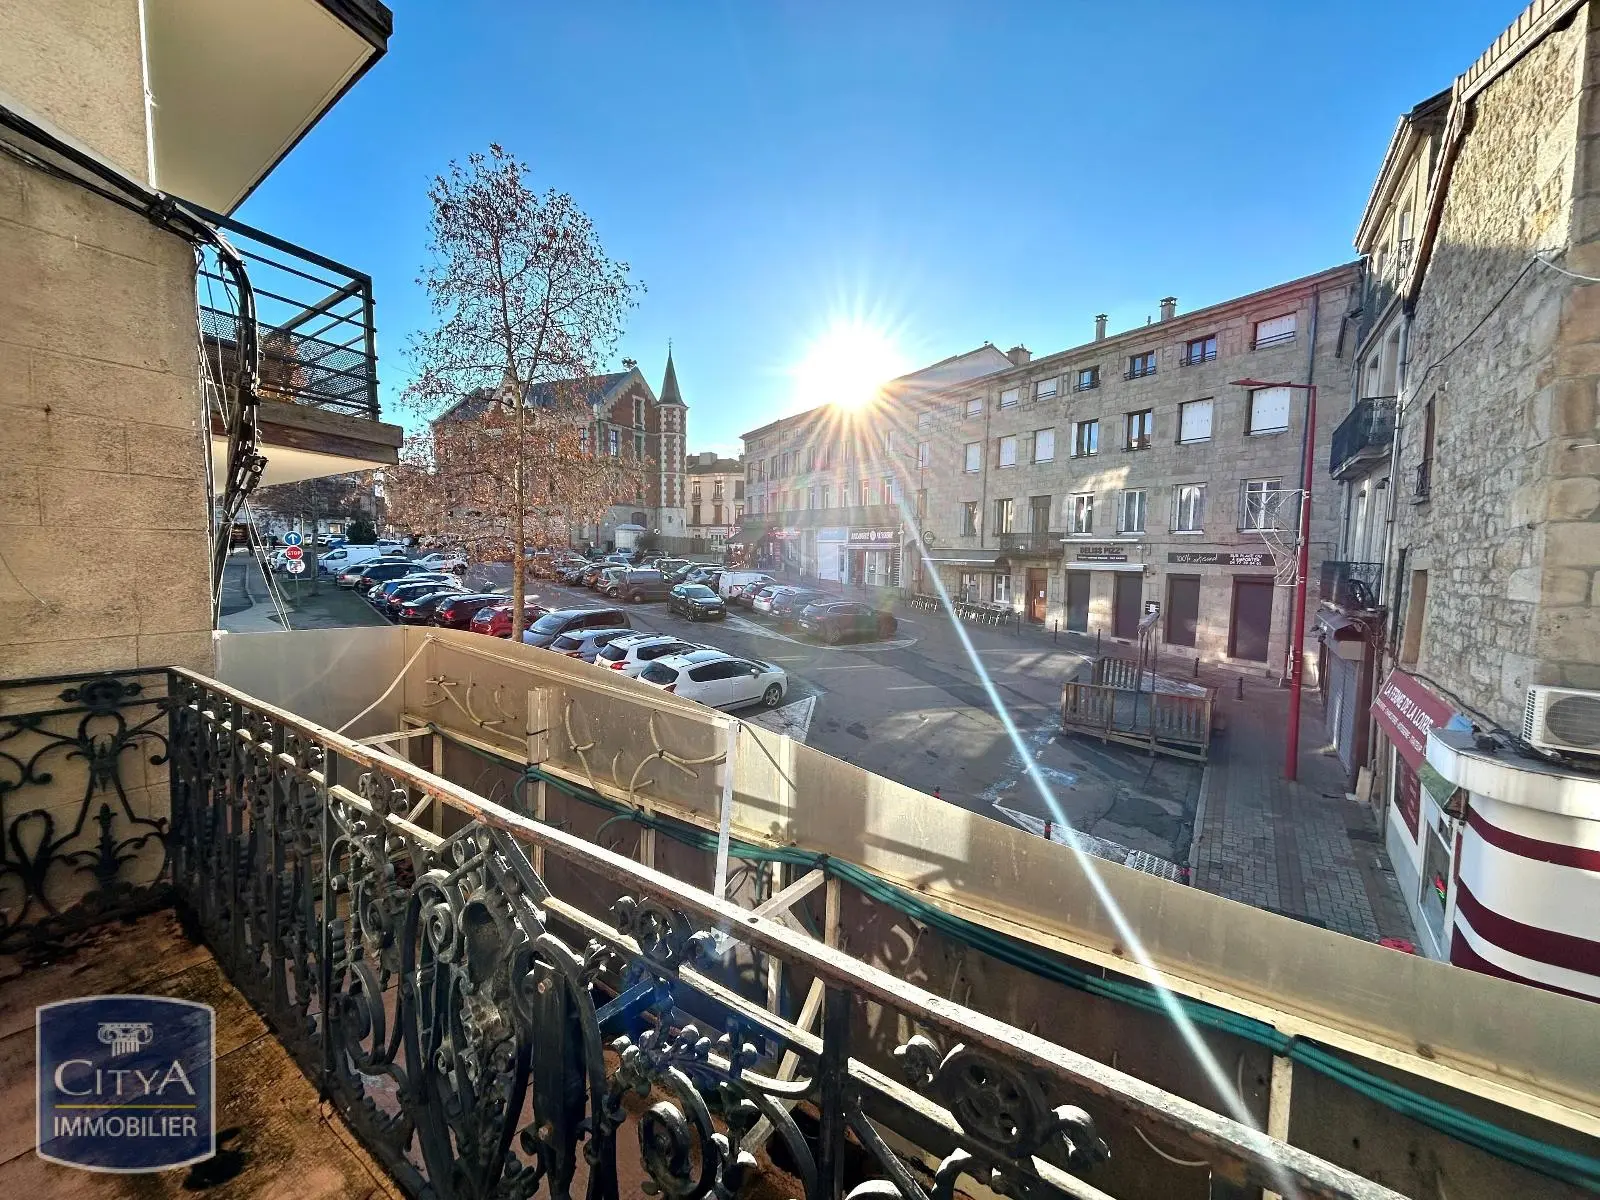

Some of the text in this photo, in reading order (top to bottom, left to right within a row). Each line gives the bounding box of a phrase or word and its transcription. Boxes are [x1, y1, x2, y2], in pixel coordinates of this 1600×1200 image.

[1384, 682, 1394, 699] LA
[1400, 698, 1413, 714] DE
[1406, 702, 1418, 721] LA
[1412, 708, 1434, 735] LOIRE
